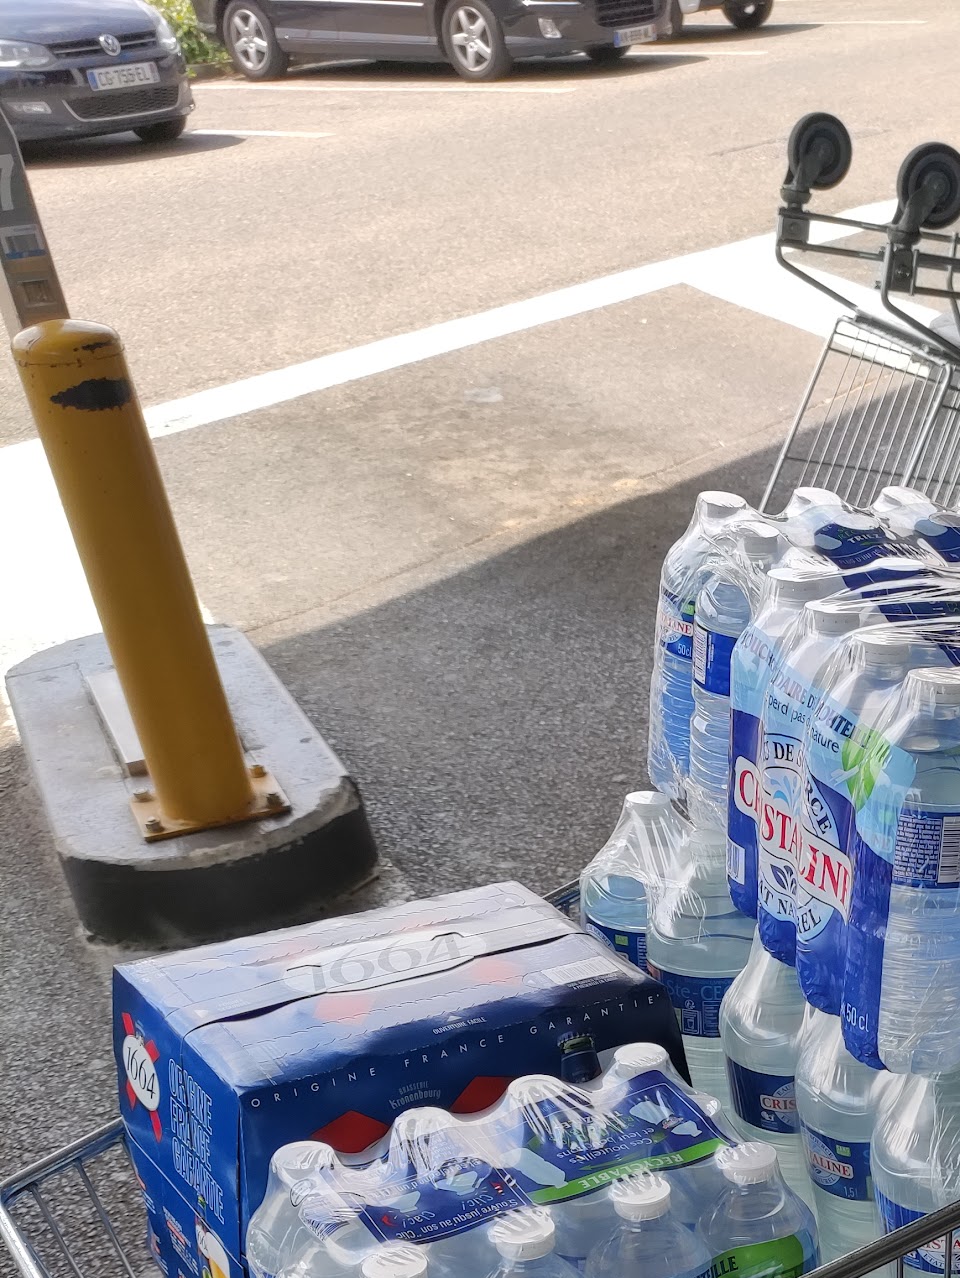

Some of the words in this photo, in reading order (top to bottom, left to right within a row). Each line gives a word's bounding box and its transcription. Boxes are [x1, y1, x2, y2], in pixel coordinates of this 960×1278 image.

[767, 694, 790, 717] perd
[773, 740, 794, 763] DE
[311, 934, 461, 992] 1664
[432, 1018, 466, 1036] OUVERTURE
[466, 1016, 487, 1029] FACILE
[125, 1046, 157, 1100] 1664
[250, 1066, 376, 1108] ORIGINE
[404, 1034, 504, 1068] FRANCE
[168, 1058, 213, 1137] ORIGINE
[170, 1095, 212, 1172] FRANCE
[172, 1136, 225, 1225] GARANTIE
[577, 1153, 684, 1189] RECYCLABLE
[812, 1155, 852, 1177] ALINE
[420, 1223, 439, 1235] son
